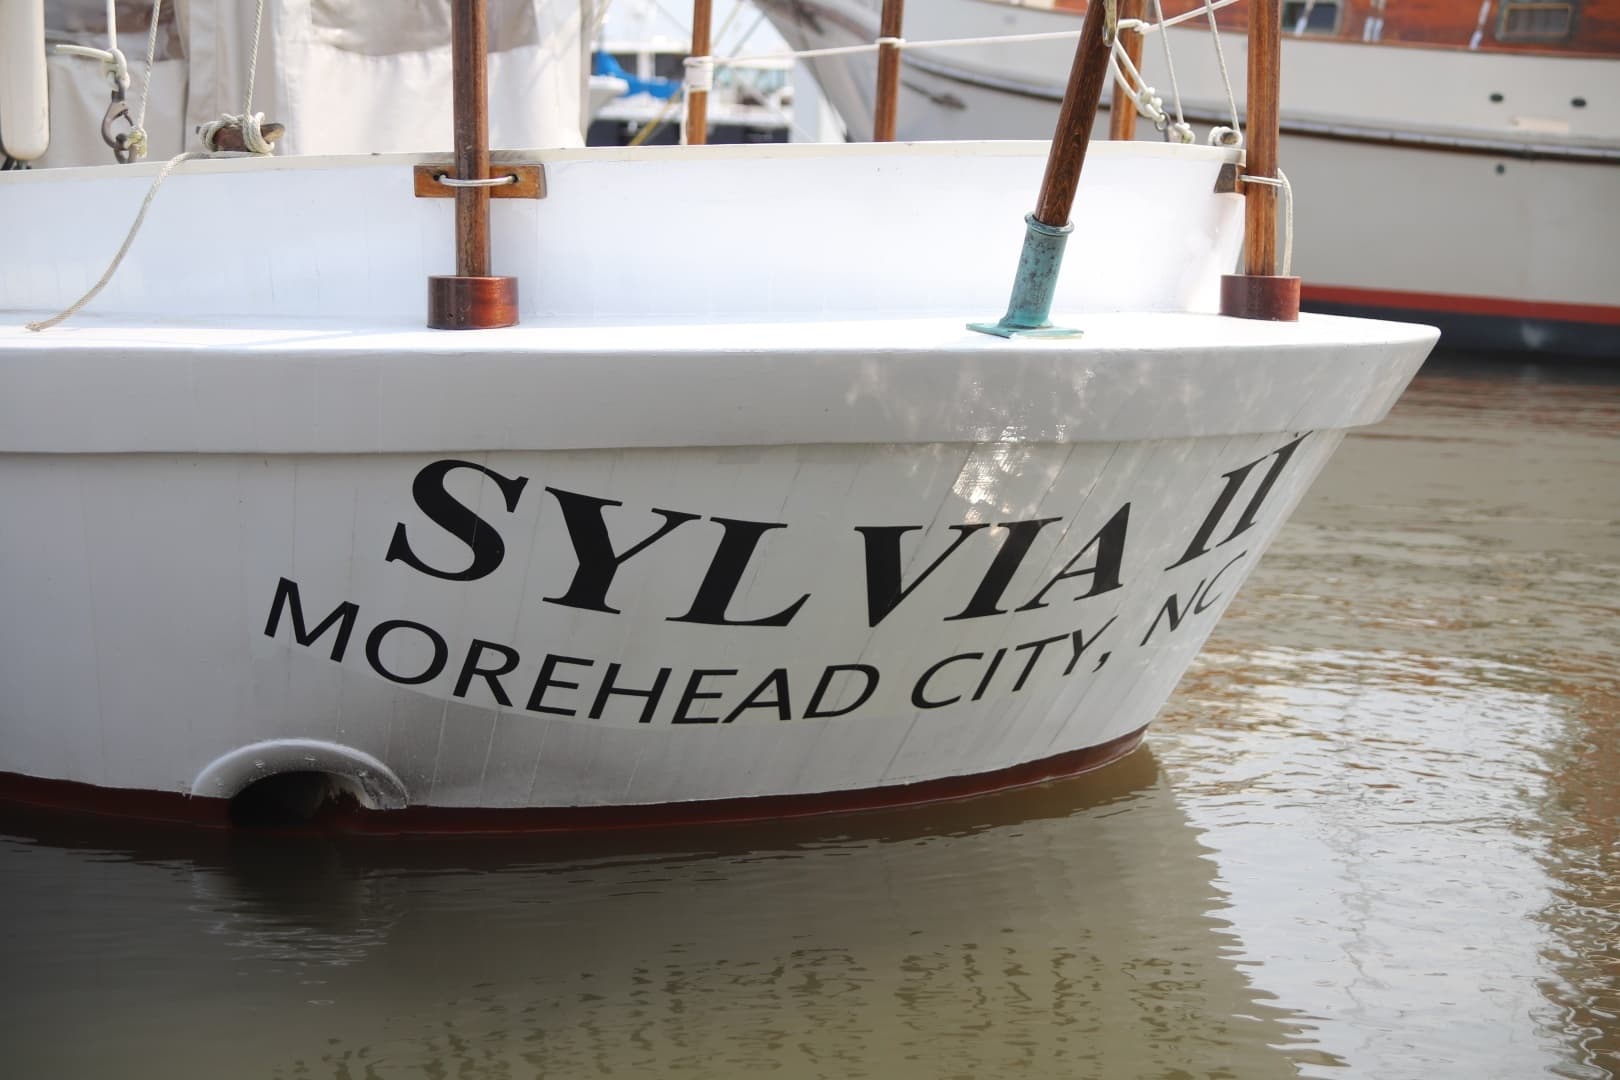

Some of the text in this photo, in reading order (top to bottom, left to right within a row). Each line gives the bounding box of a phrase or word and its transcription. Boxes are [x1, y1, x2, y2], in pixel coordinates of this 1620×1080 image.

[386, 429, 1314, 628] SYLVIA II
[264, 550, 1247, 725] MOREHEAD CITY, NC
